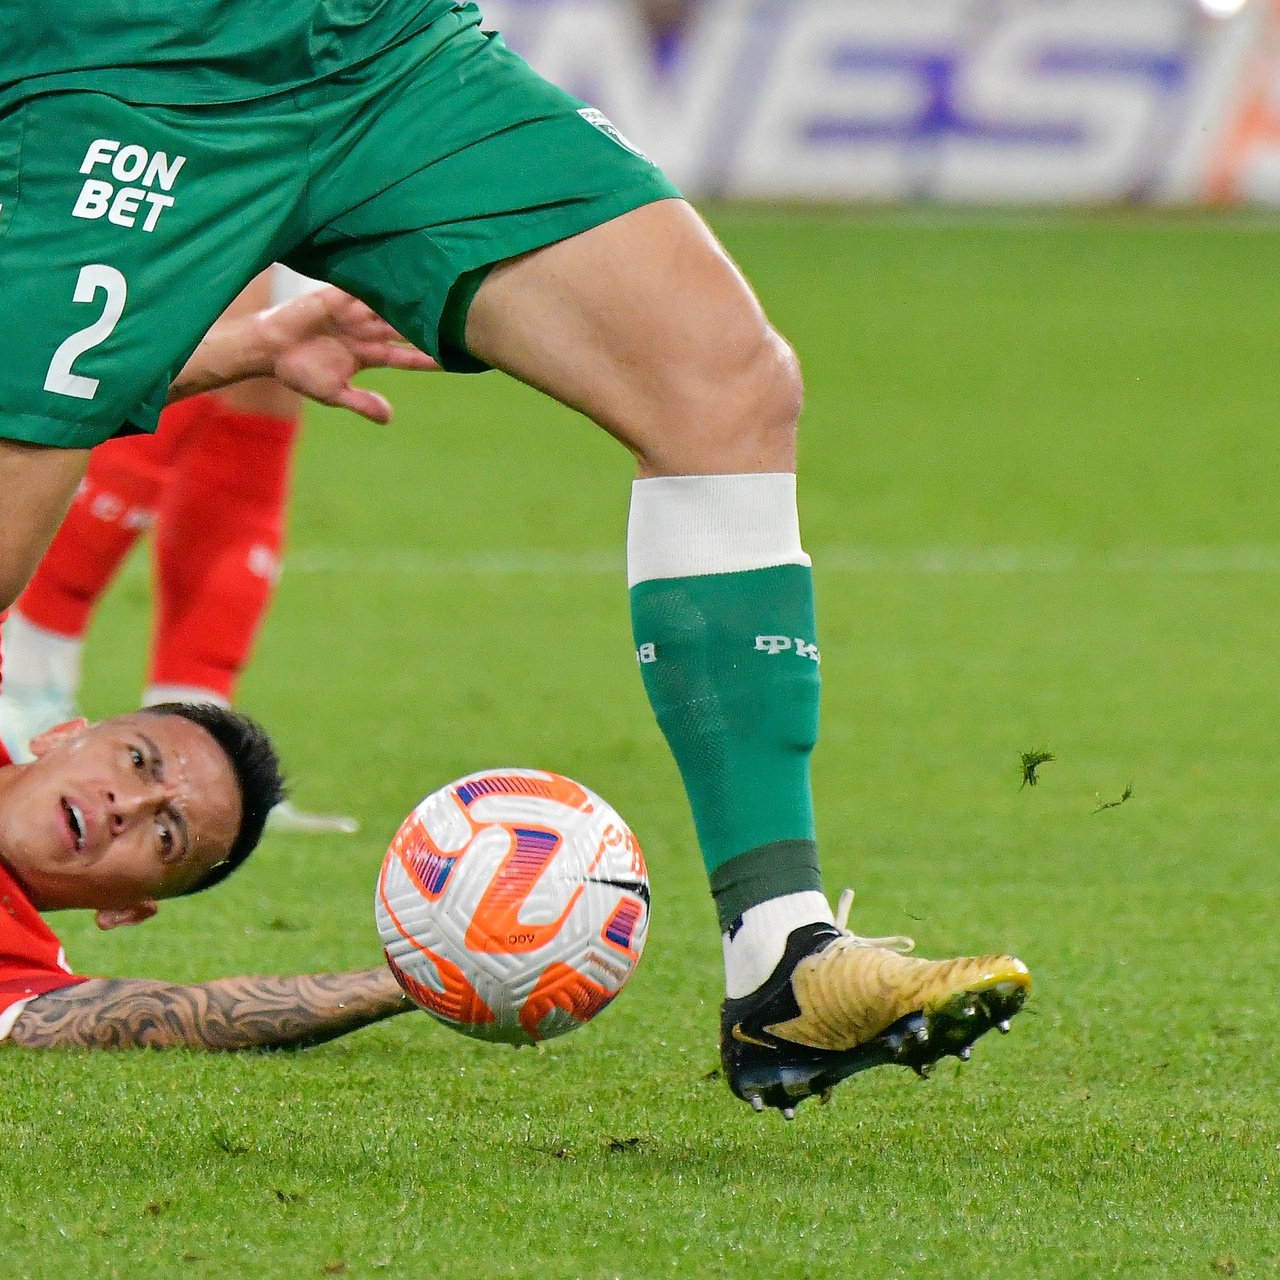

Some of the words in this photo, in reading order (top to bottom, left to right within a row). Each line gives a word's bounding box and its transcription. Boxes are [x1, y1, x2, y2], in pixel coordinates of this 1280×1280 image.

[79, 138, 187, 191] FON
[71, 178, 175, 233] BET
[43, 263, 128, 401] 2
